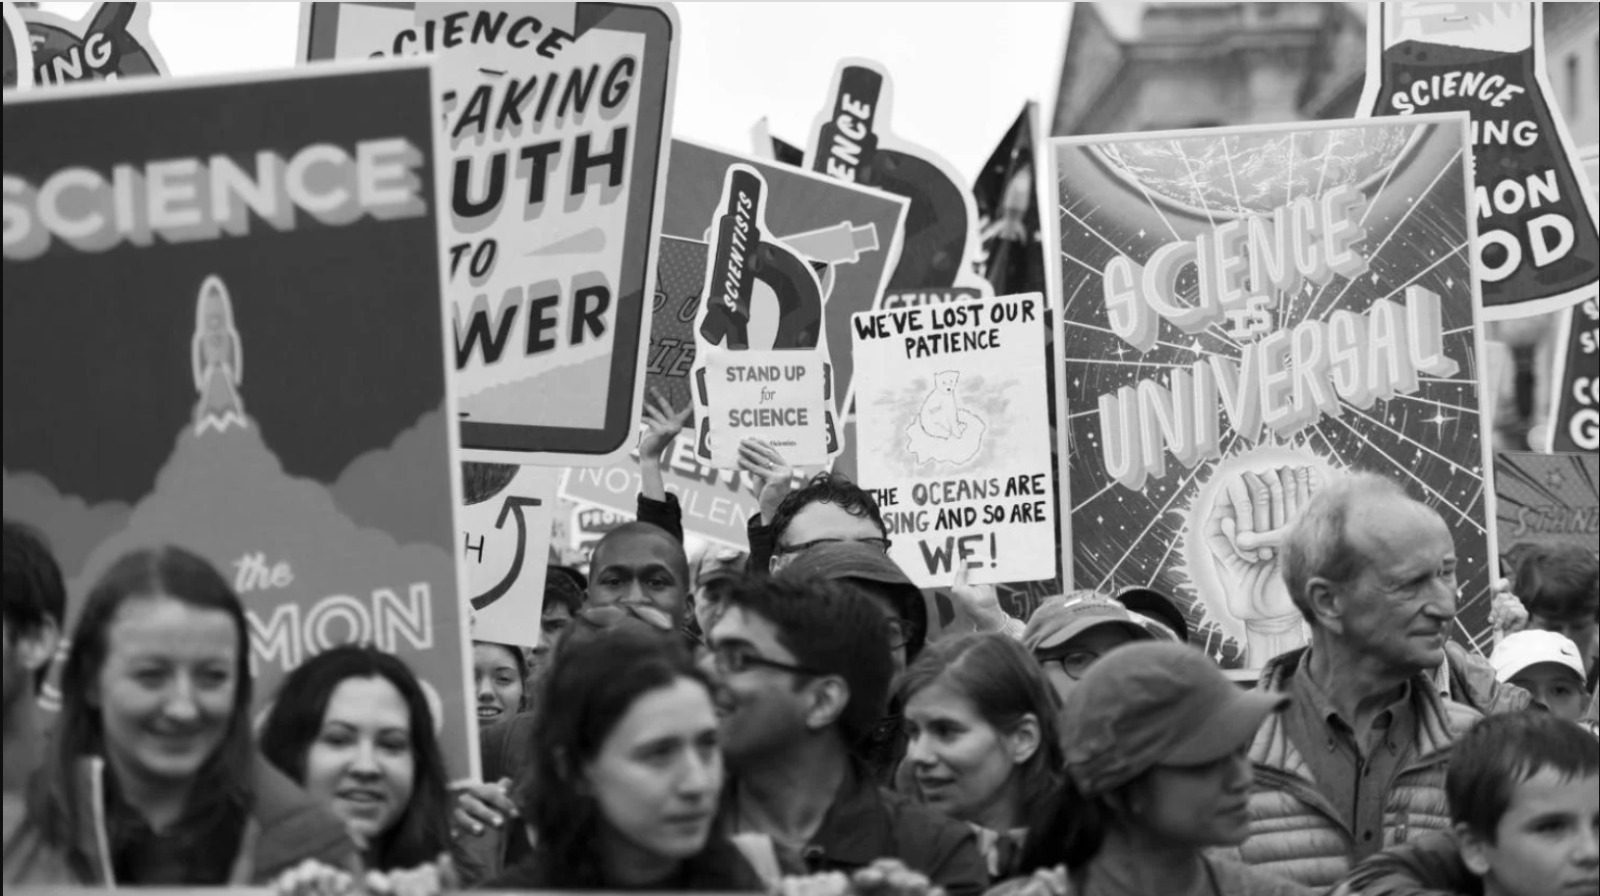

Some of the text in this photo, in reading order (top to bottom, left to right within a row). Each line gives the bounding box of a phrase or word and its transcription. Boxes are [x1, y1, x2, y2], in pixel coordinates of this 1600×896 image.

[369, 11, 576, 60] CIENCE
[39, 32, 112, 87] ING
[442, 57, 636, 138] AKING
[1391, 71, 1526, 116] SCIENCE
[452, 125, 630, 218] UTH
[2, 137, 428, 260] SCIENCE
[449, 238, 498, 279] TO
[723, 190, 753, 313] SCIENTISTS
[1102, 183, 1370, 353] SCIENCE
[854, 300, 1036, 341] WE'VE LOST OUR
[1223, 292, 1274, 338] IS
[905, 328, 1001, 359] PATIENCE
[726, 365, 806, 383] STAND UP
[759, 386, 776, 404] for
[1097, 283, 1461, 491] UNIVERSAL
[728, 408, 809, 428] SCIENCE
[912, 478, 1001, 506] OCEANS
[1005, 473, 1046, 497] ARE
[935, 507, 977, 530] AND
[982, 504, 1005, 524] SO
[1009, 500, 1046, 524] ARE
[233, 552, 294, 593] the
[918, 532, 997, 576] WE!
